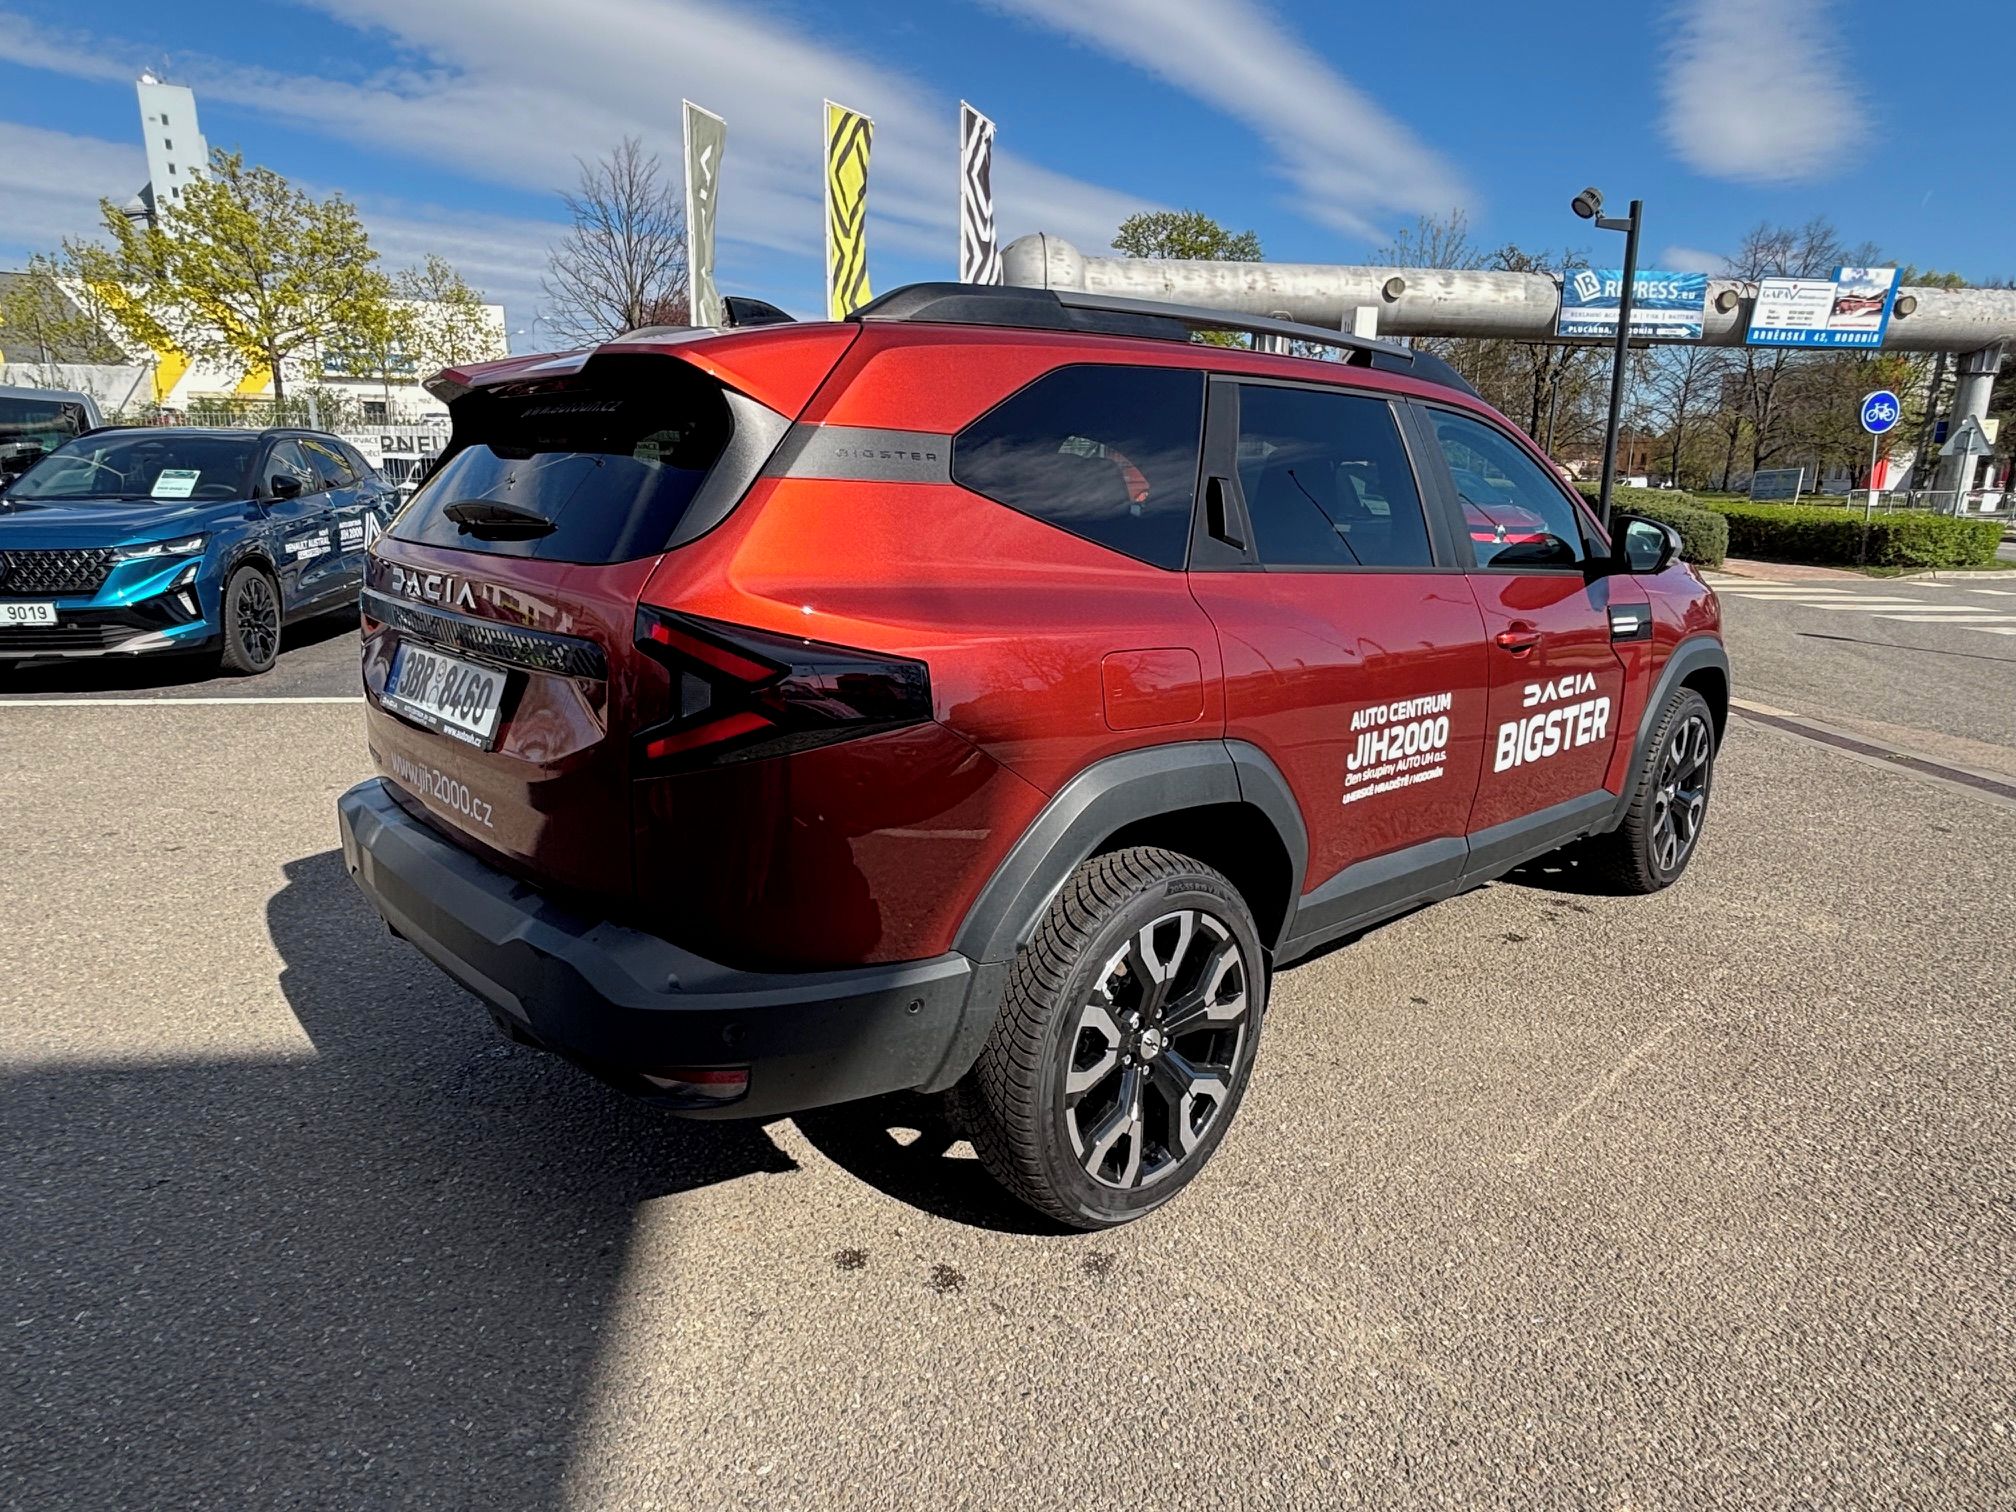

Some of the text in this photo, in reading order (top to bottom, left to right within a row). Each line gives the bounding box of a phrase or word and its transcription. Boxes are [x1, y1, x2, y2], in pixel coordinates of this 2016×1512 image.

[1835, 331, 1880, 343] HODONÍN
[835, 448, 937, 461] BIGSTER
[392, 567, 477, 609] DACIA
[7, 606, 47, 620] 9019
[400, 651, 493, 726] 3BR 8460
[1523, 671, 1596, 707] DACIA
[1350, 692, 1452, 731] AUTO CENTRUM
[1346, 715, 1449, 770] JIH2000
[1494, 696, 1610, 773] BIGSTER
[1362, 762, 1396, 782] skupiny
[1396, 755, 1420, 773] AUTO
[391, 751, 493, 828] www.jih2000.cz
